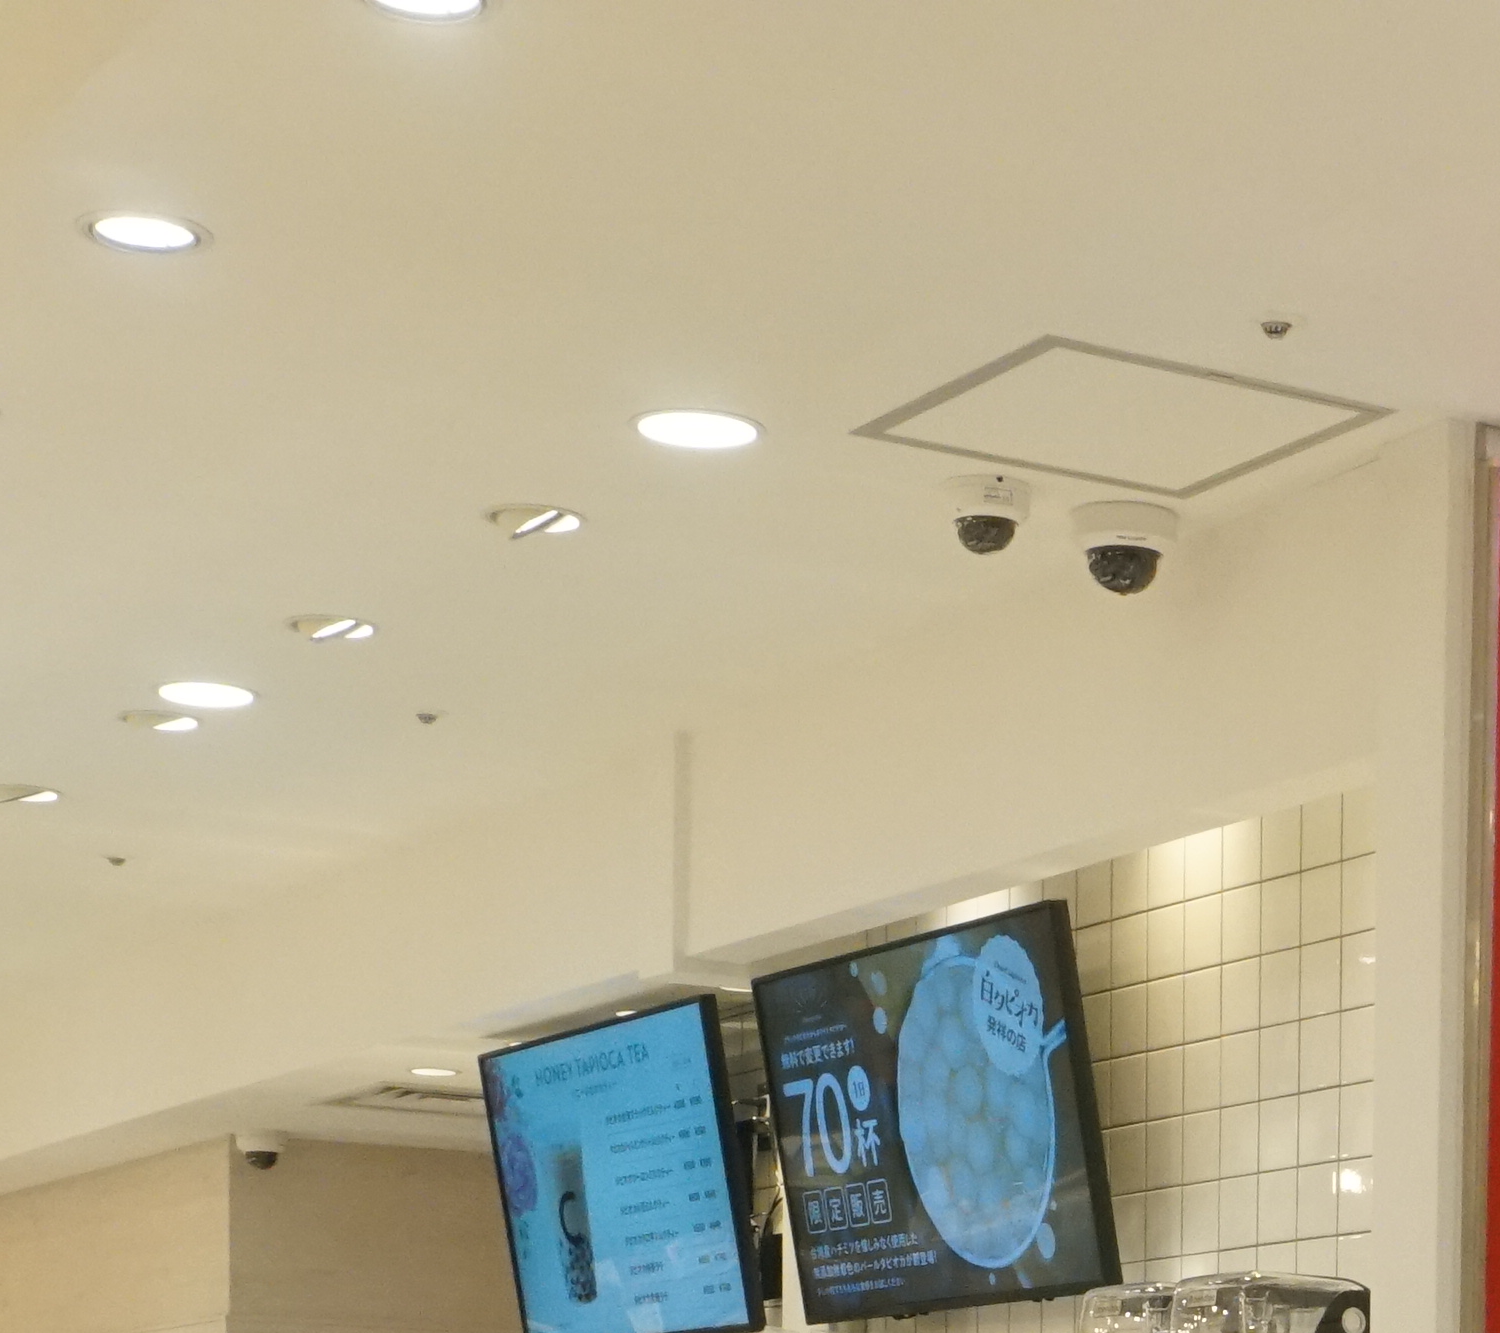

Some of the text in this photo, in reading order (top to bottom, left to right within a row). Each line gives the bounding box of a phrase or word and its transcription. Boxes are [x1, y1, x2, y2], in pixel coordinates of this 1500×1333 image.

[535, 1065, 573, 1087] HONEY
[575, 1052, 625, 1079] TAPIOCA
[627, 1042, 650, 1065] TEA
[783, 1073, 853, 1178] 70
[855, 1117, 880, 1169] 杯
